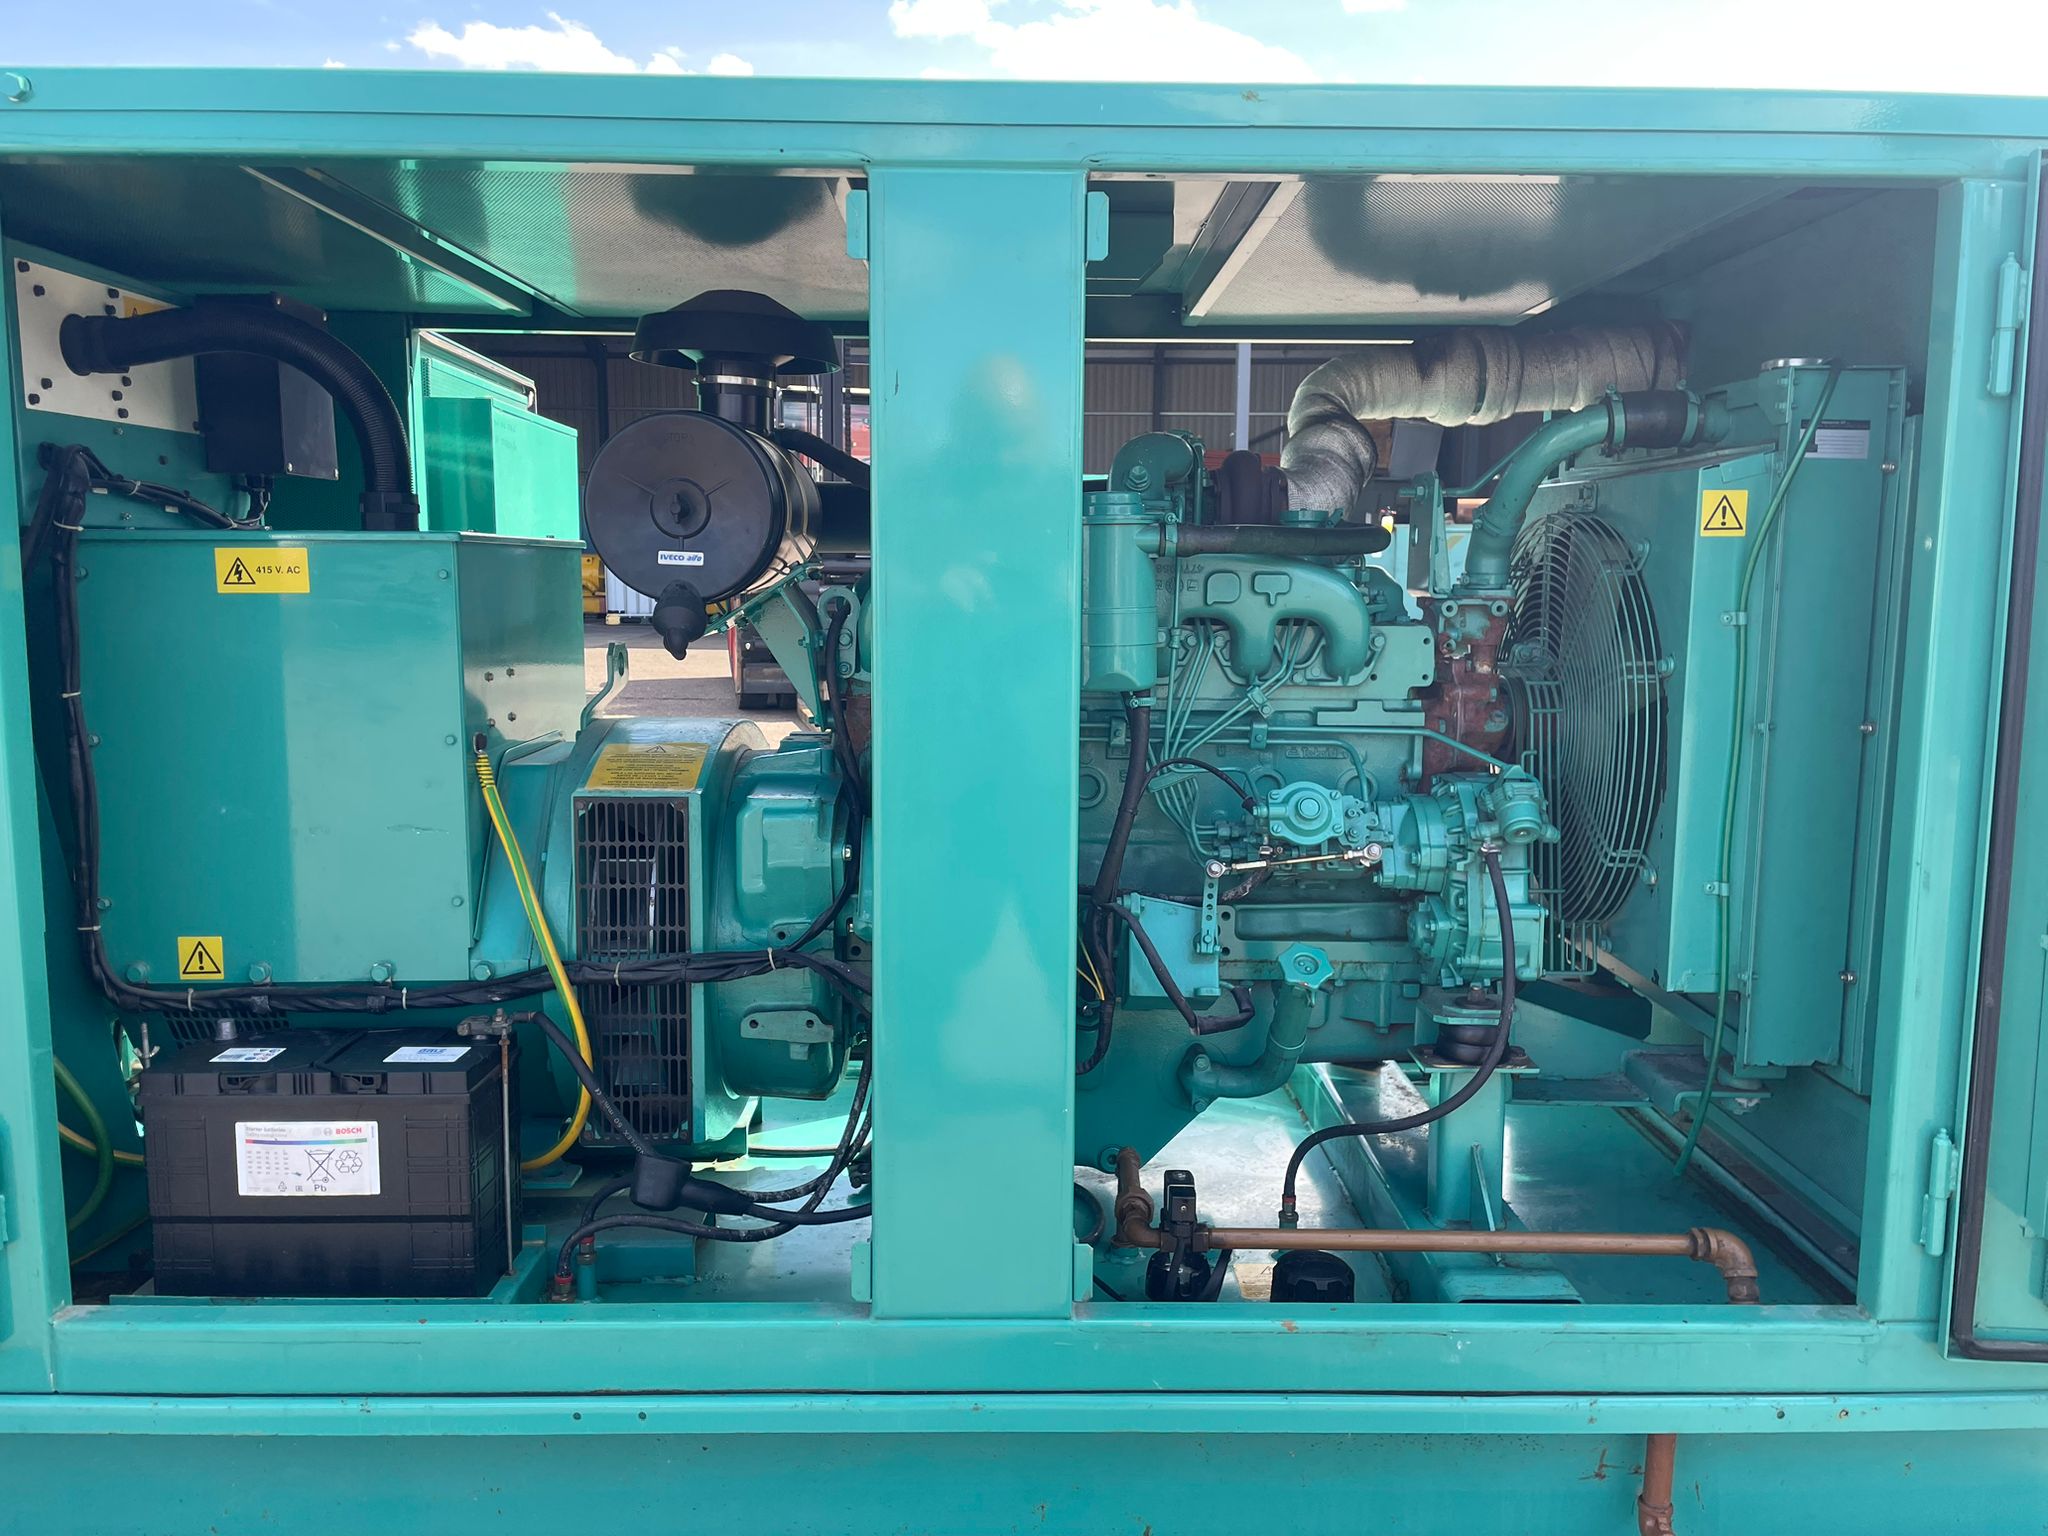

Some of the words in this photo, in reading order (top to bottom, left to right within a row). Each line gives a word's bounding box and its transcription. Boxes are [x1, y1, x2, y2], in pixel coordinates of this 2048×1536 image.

[255, 566, 273, 574] 415
[275, 566, 284, 574] V.
[286, 566, 301, 574] AC
[335, 1127, 362, 1135] BOSCH
[314, 1184, 327, 1192] Pb
